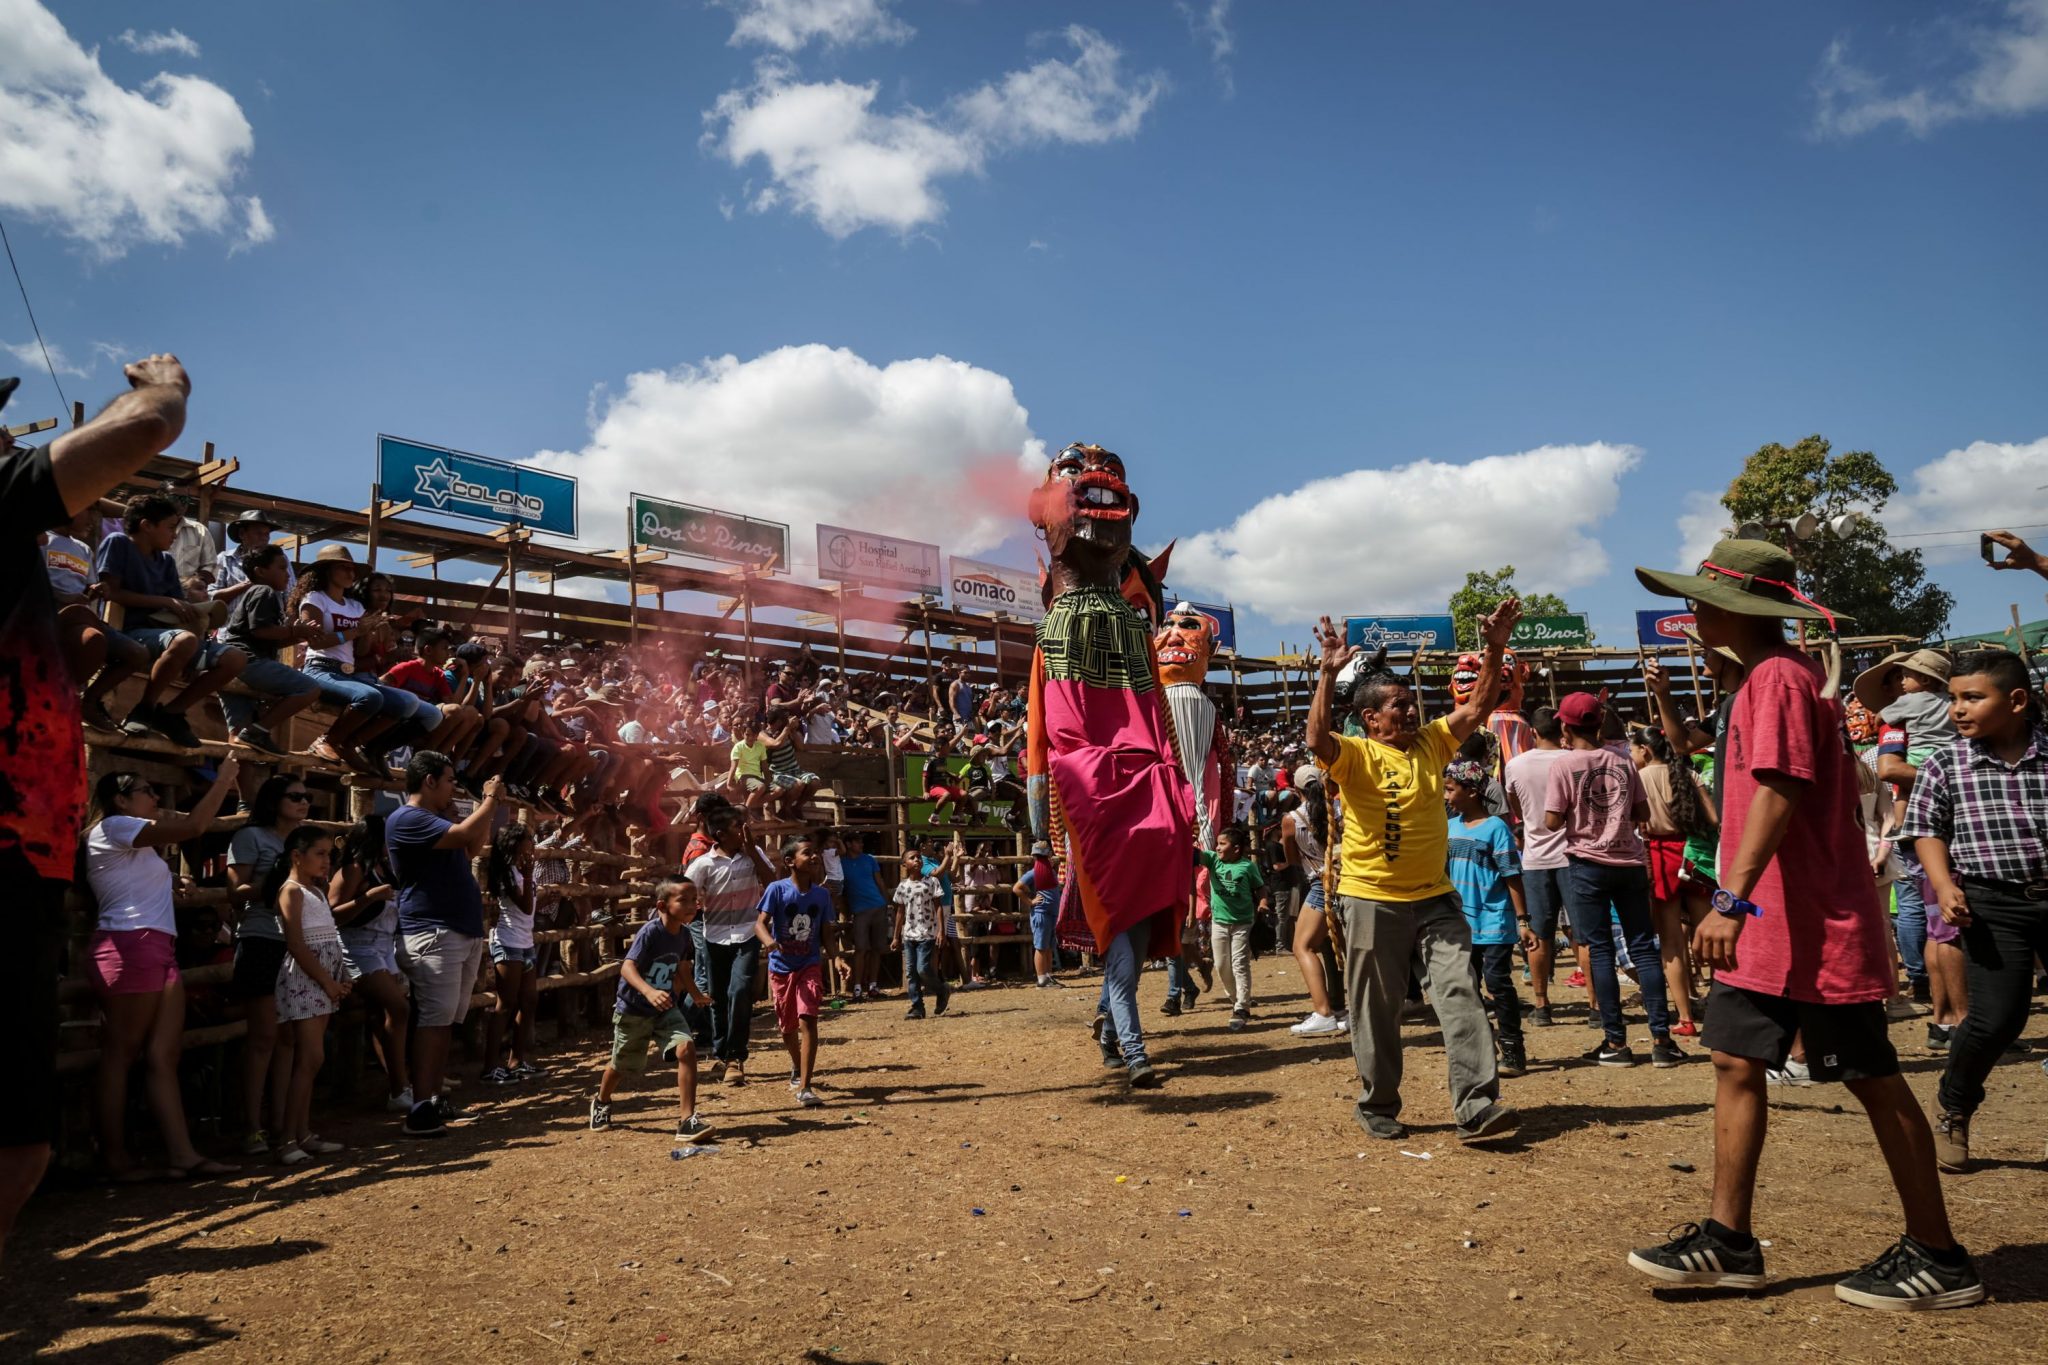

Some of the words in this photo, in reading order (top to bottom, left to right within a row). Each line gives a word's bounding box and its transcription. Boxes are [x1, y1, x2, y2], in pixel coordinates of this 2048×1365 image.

[453, 482, 542, 511] COLONO
[641, 511, 686, 541] Dos
[712, 525, 776, 557] Pinos
[859, 541, 898, 558] Hospital
[859, 559, 874, 567] San
[953, 579, 1016, 603] comaco
[1383, 631, 1435, 640] COLONO
[1533, 622, 1585, 640] Pinos
